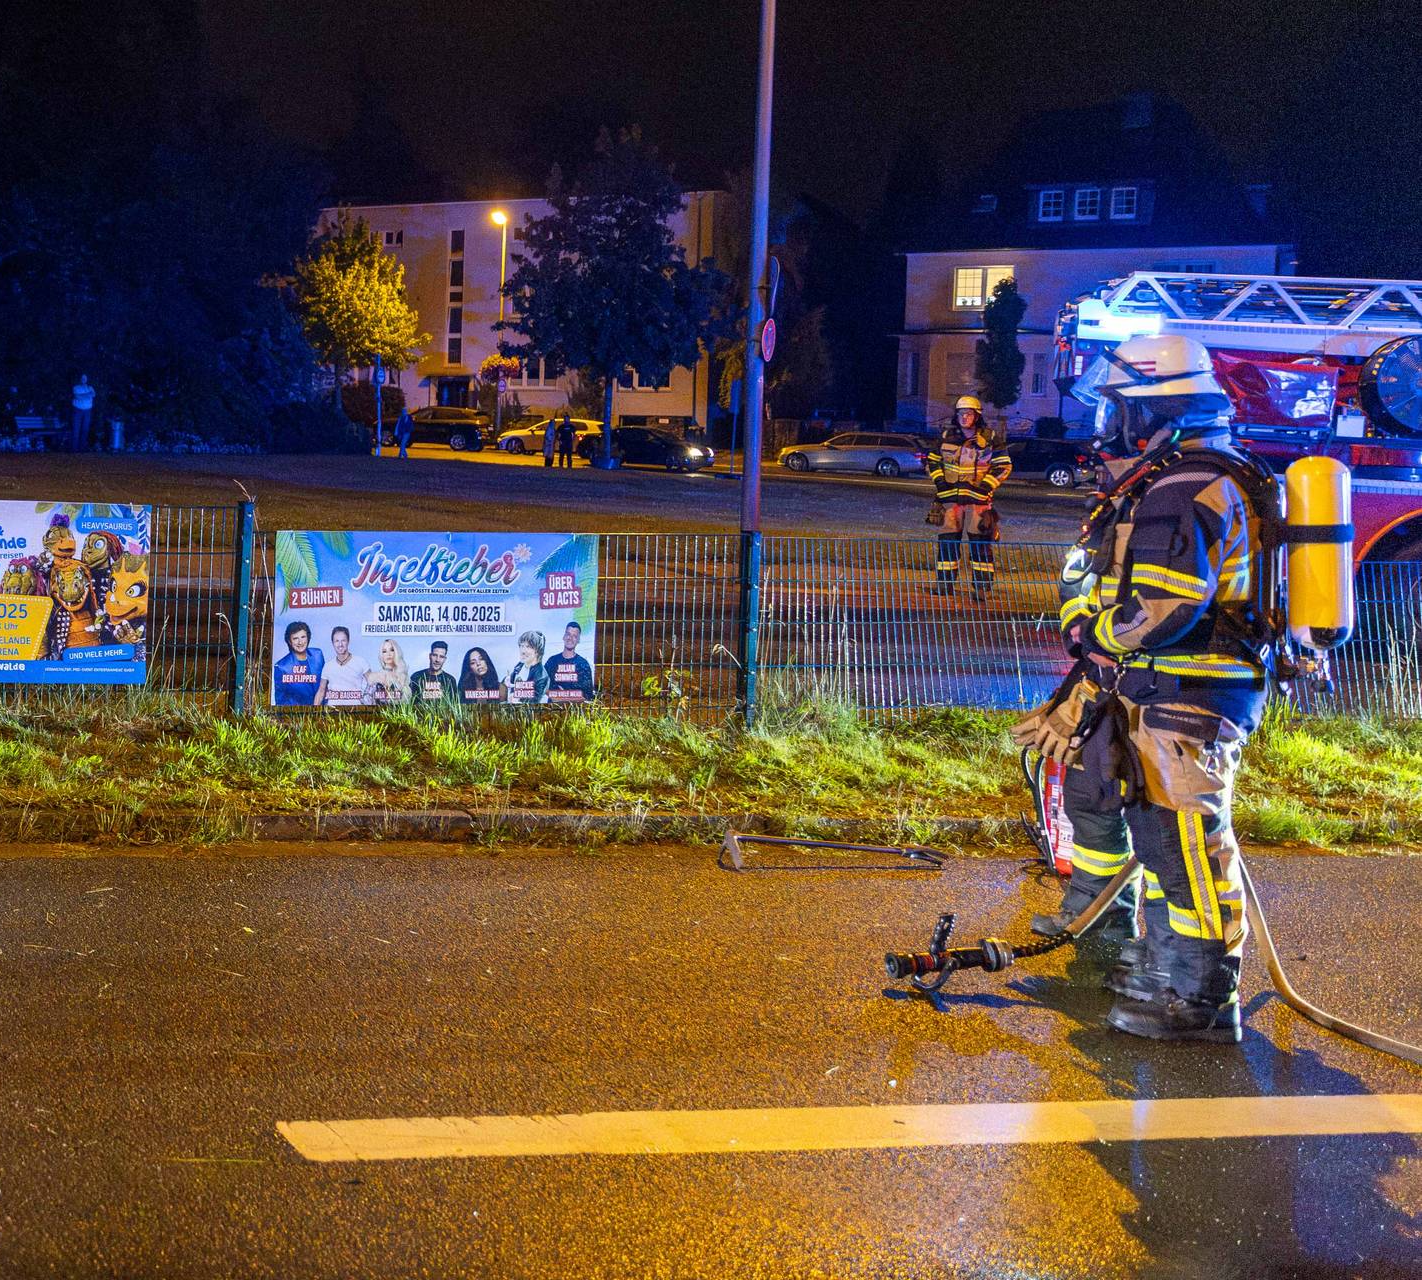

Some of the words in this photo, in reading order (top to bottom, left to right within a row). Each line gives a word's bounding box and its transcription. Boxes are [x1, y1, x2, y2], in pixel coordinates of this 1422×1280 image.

[81, 521, 133, 531] HEAVYSAURUS
[351, 541, 520, 594] Inselfieber
[549, 575, 573, 590] ÜBER
[291, 592, 298, 606] 2
[300, 589, 340, 605] BÜHNEN
[543, 592, 555, 606] 30
[557, 591, 579, 605] ACTS
[378, 605, 434, 623] SAMSTAG,
[4, 622, 18, 630] Uhr
[365, 623, 402, 633] FREIGELÄNDE
[402, 624, 413, 633] DER
[413, 624, 434, 633] RUDOLF
[478, 624, 513, 633] OBERHAUSEN
[292, 665, 307, 674] OLAF
[282, 675, 293, 683] DER
[294, 675, 317, 683] FLIPPER
[464, 690, 489, 699] VANESSA
